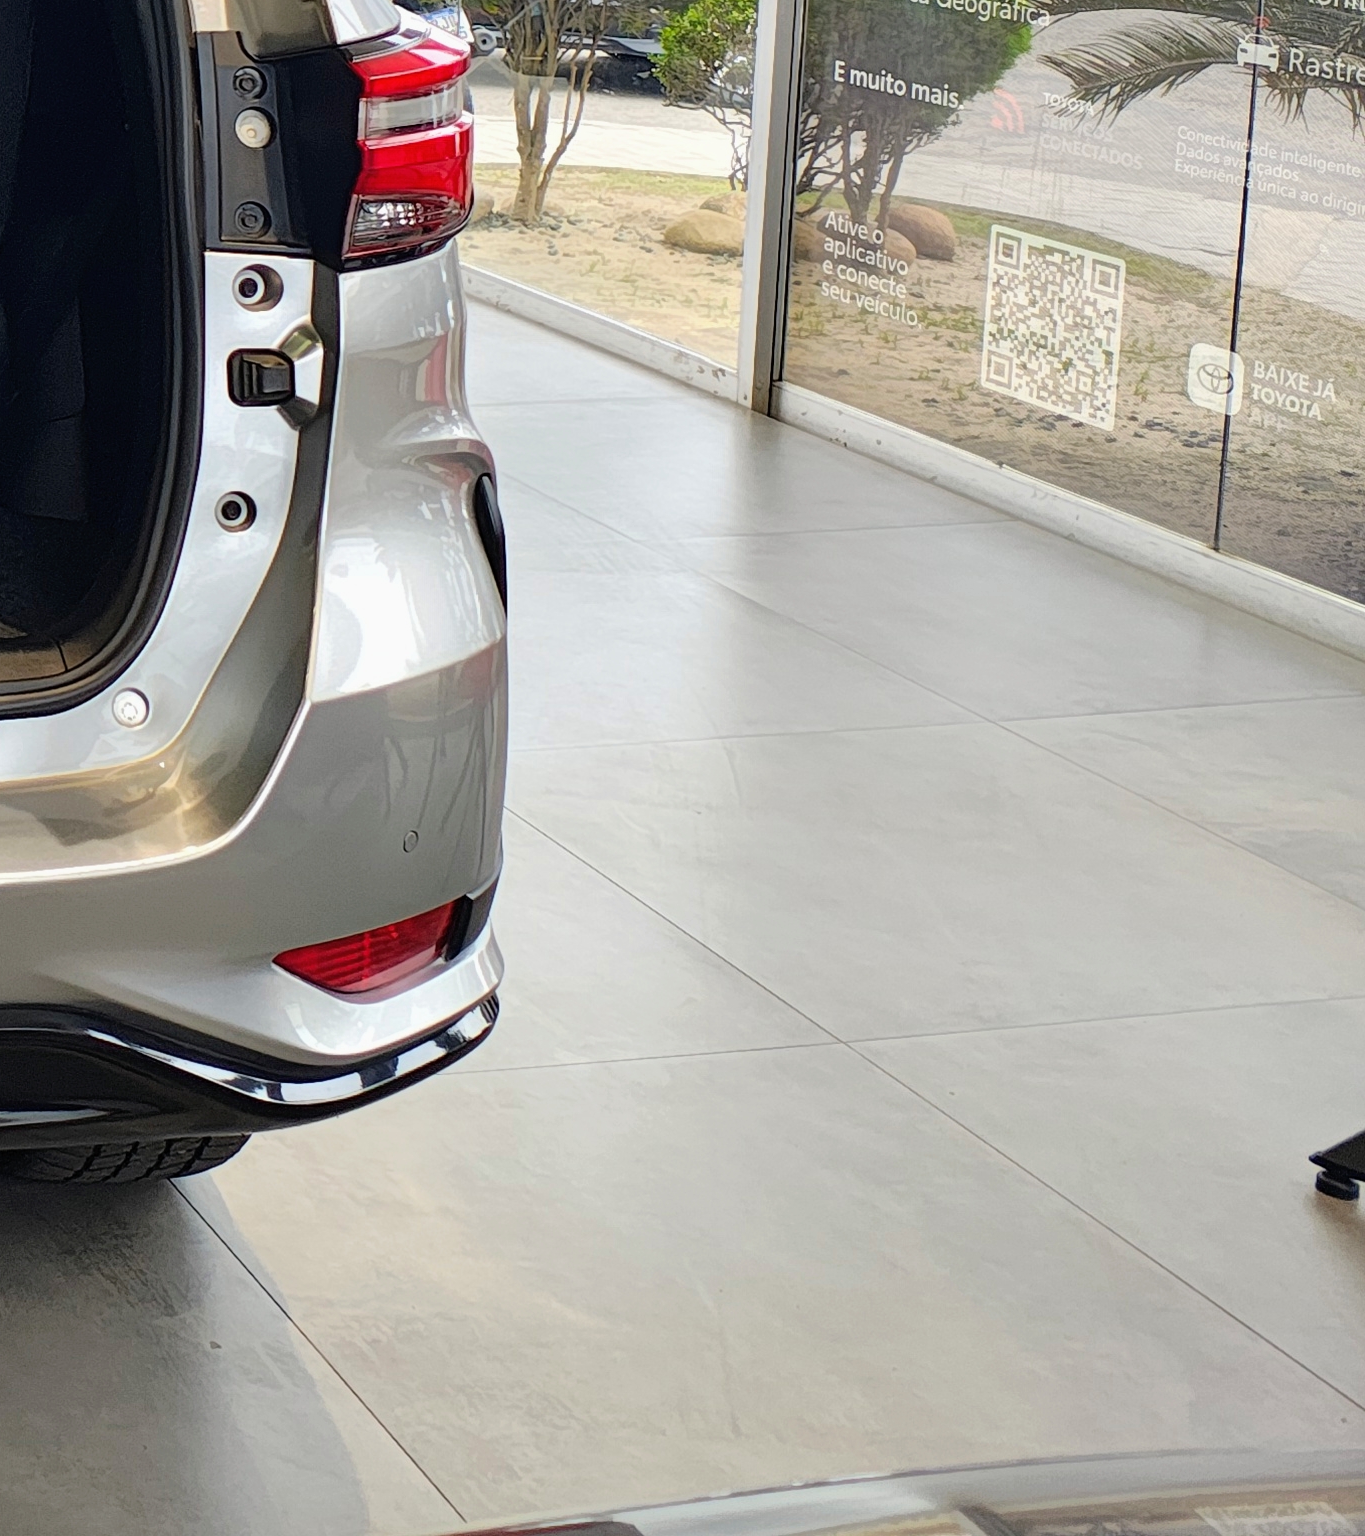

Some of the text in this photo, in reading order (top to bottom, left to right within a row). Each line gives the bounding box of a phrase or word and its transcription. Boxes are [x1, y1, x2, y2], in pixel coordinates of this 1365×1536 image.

[833, 59, 965, 111] E muito mais.
[1043, 91, 1095, 116] TOYOTA
[1039, 133, 1144, 171] CONECTADOS
[1176, 141, 1220, 164] Dados
[1177, 125, 1277, 159] Conectividade
[1174, 158, 1254, 189] Experiência
[1257, 176, 1297, 199] única
[1300, 189, 1319, 204] ao
[824, 210, 884, 244] Ative o
[823, 236, 909, 276] aplicativo
[820, 280, 851, 304] seu
[822, 259, 907, 299] e conecte
[1253, 360, 1338, 404] BAIXE JÁ
[1250, 383, 1325, 421] TOYOTA
